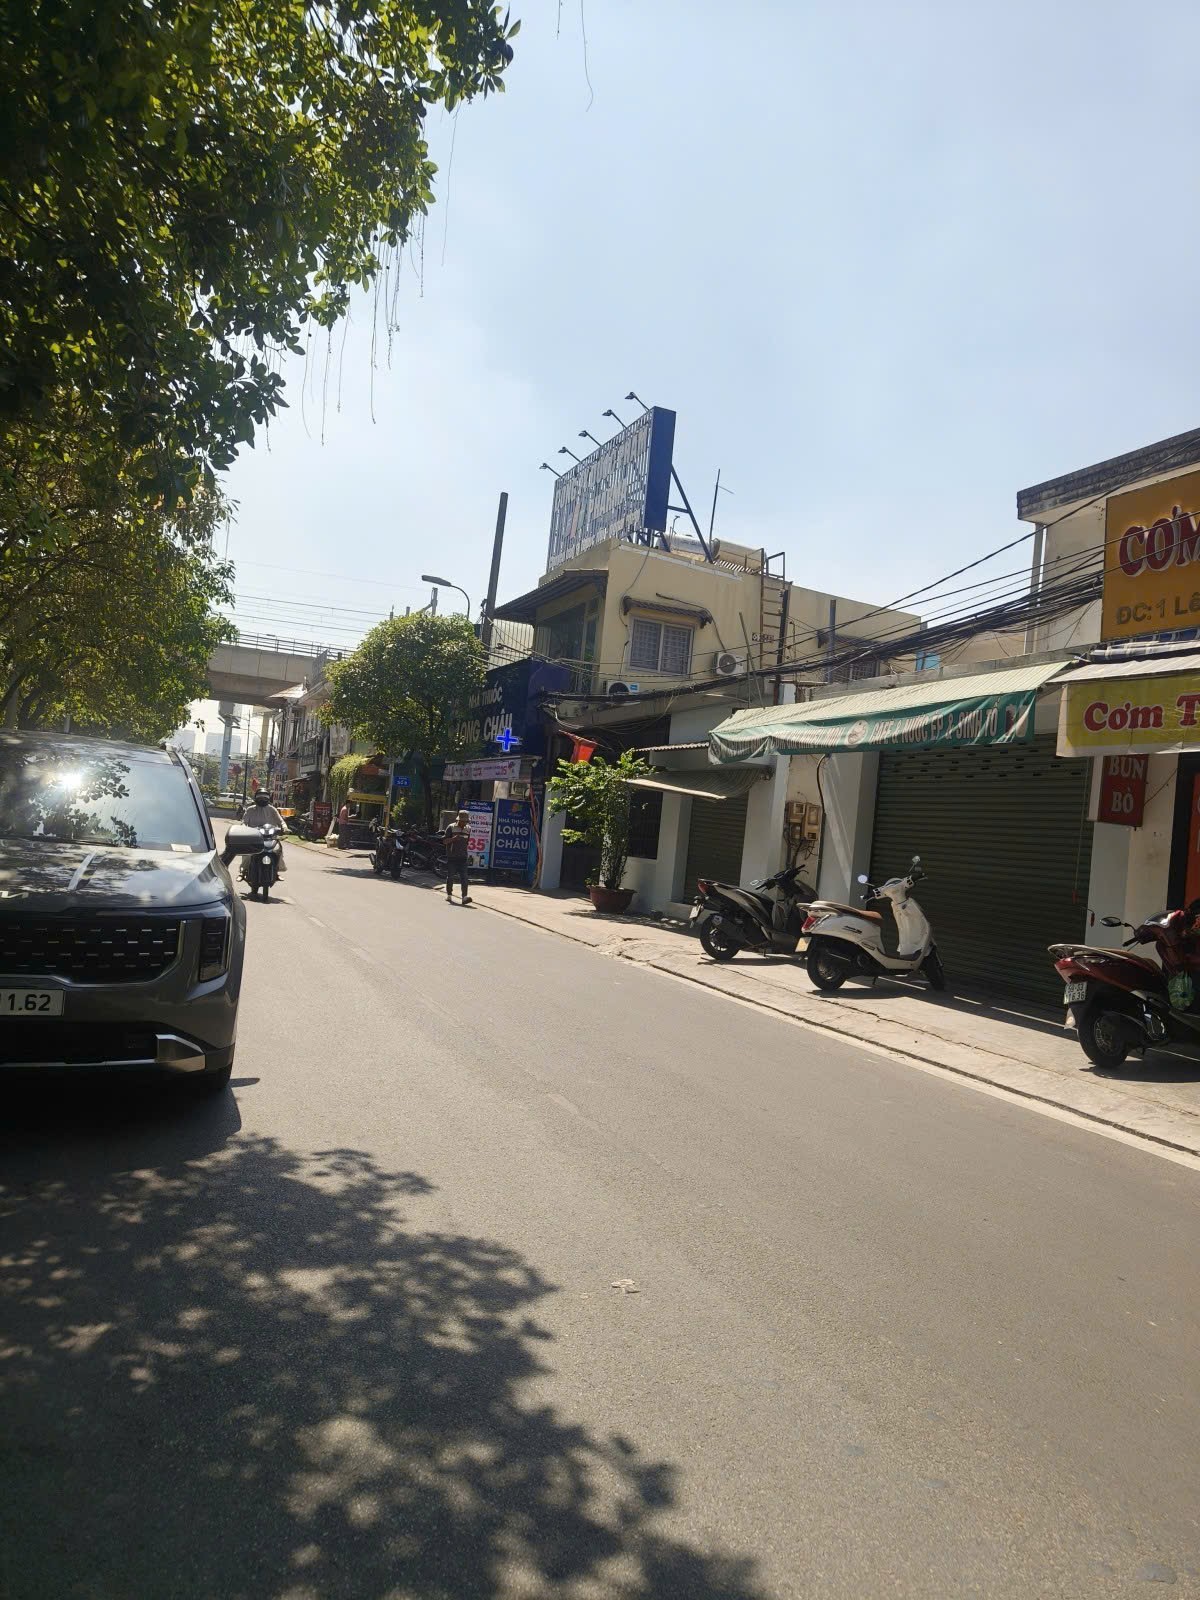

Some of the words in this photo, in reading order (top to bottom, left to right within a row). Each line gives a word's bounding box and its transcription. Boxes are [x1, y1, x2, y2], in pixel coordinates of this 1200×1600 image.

[956, 708, 983, 739] SINH
[1084, 701, 1164, 732] Cơm
[1111, 786, 1134, 814] BÒ
[496, 838, 528, 850] CHÂU
[498, 825, 529, 836] LONG
